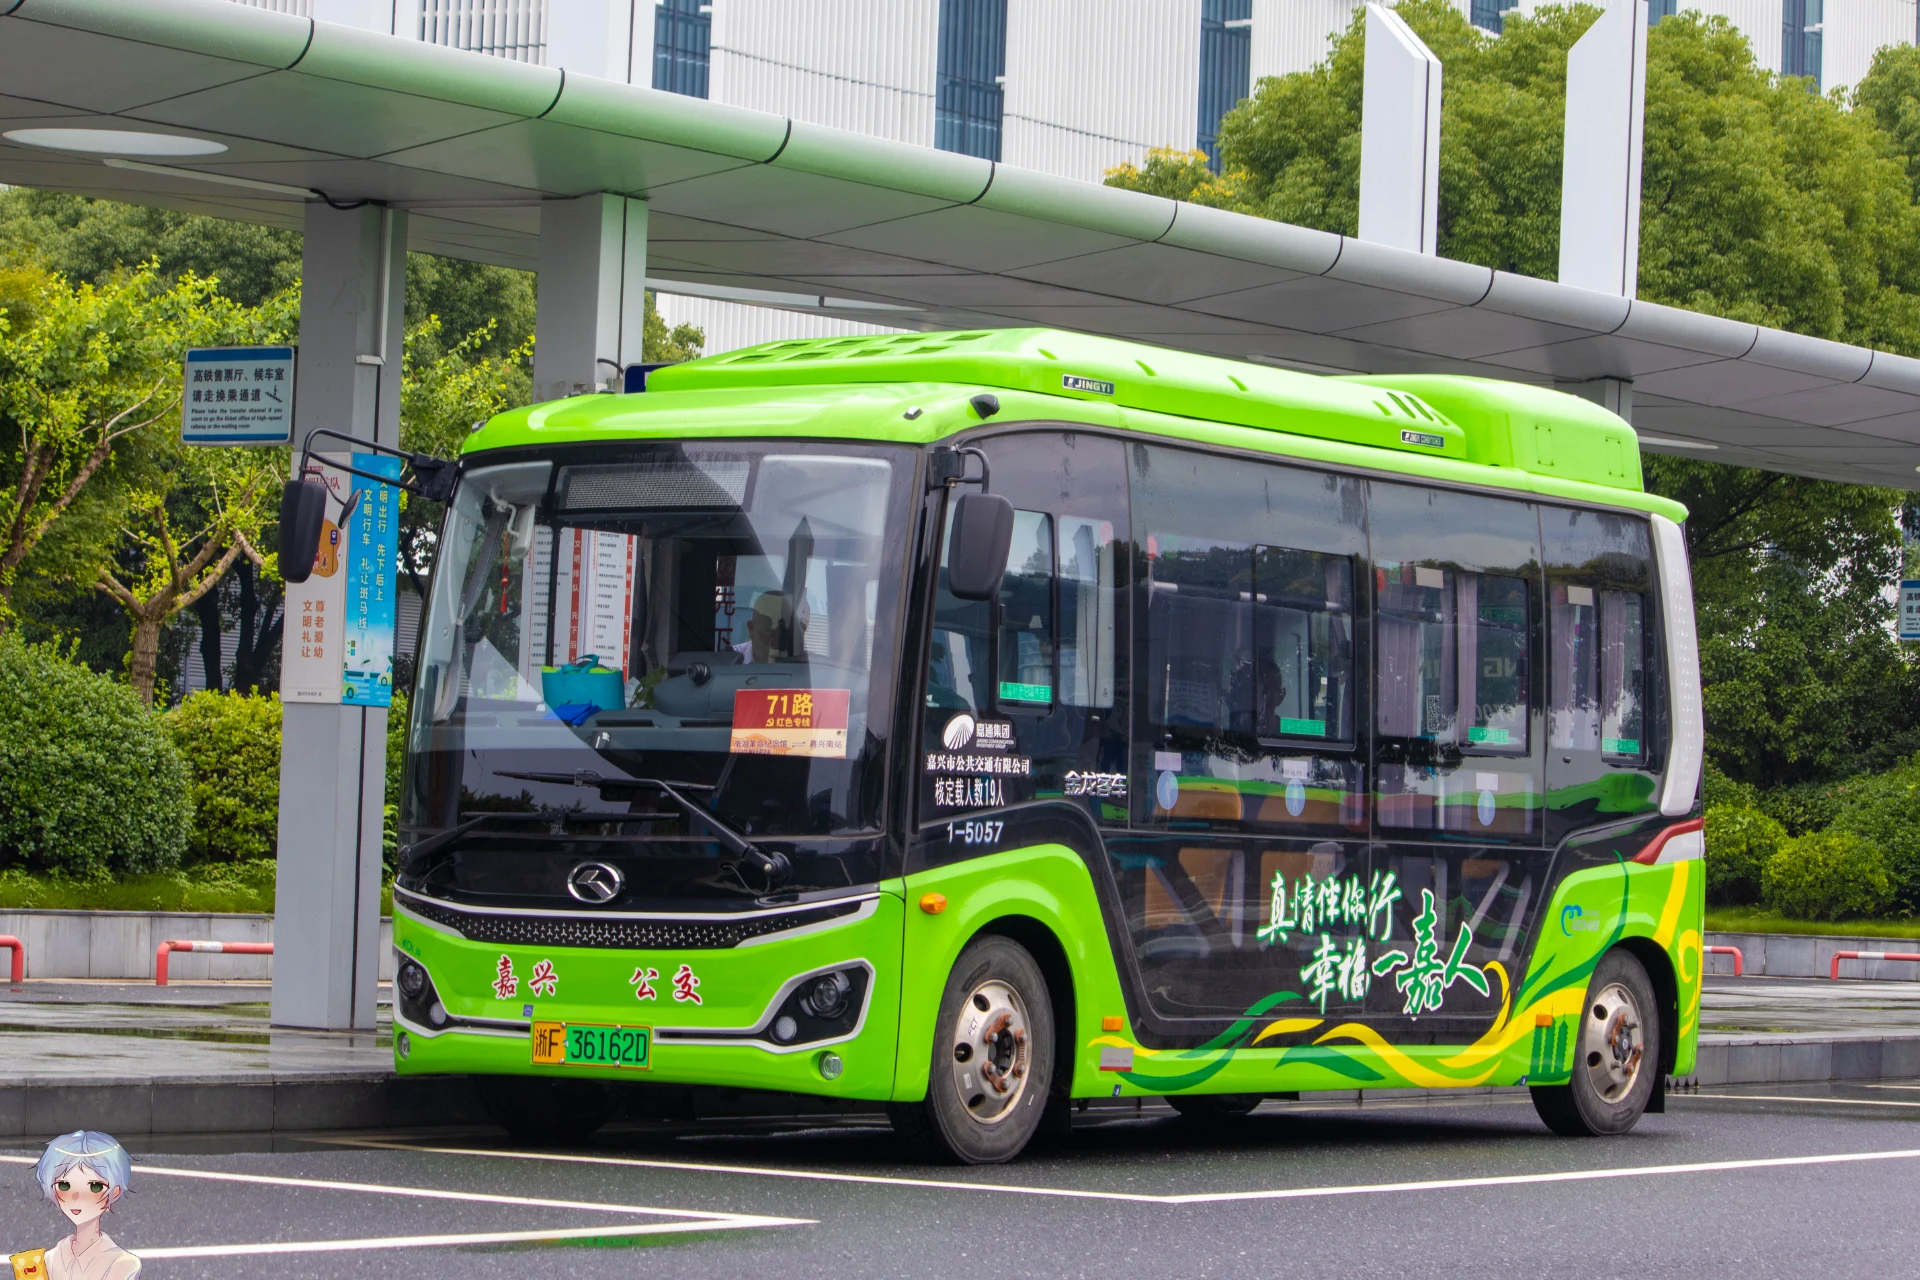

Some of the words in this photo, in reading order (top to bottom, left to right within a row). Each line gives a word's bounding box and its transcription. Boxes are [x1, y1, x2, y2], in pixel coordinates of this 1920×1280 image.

[194, 368, 285, 382] 高铁售票厅、候车室
[1075, 379, 1111, 393] JINGYI
[192, 389, 261, 402] 请走换乘通道
[362, 488, 373, 546] 文明行车
[375, 544, 386, 602] 先下后上
[573, 540, 582, 592] 文明排队
[358, 557, 371, 630] 礼让斑马线
[301, 600, 312, 659] 文明礼让
[314, 600, 325, 659] 尊老爱幼
[767, 693, 813, 716] 71路
[776, 717, 811, 727] 红色专线
[976, 723, 1010, 739] 嘉通集团
[734, 740, 788, 748] 南湖革命纪念馆
[809, 740, 843, 749] 嘉兴南站
[926, 754, 1031, 775] 嘉兴市公共交通有限公司
[935, 777, 1005, 807] 核定载人数19人
[1063, 770, 1127, 798] 金龙客车
[947, 821, 1004, 844] 1-5057
[1257, 869, 1402, 945] 真情伴你行
[1300, 888, 1490, 1021] 幸福一嘉人
[493, 954, 558, 1000] 嘉兴
[630, 964, 702, 1005] 公交
[535, 1028, 561, 1058] 浙F
[570, 1029, 647, 1062] 36162D
